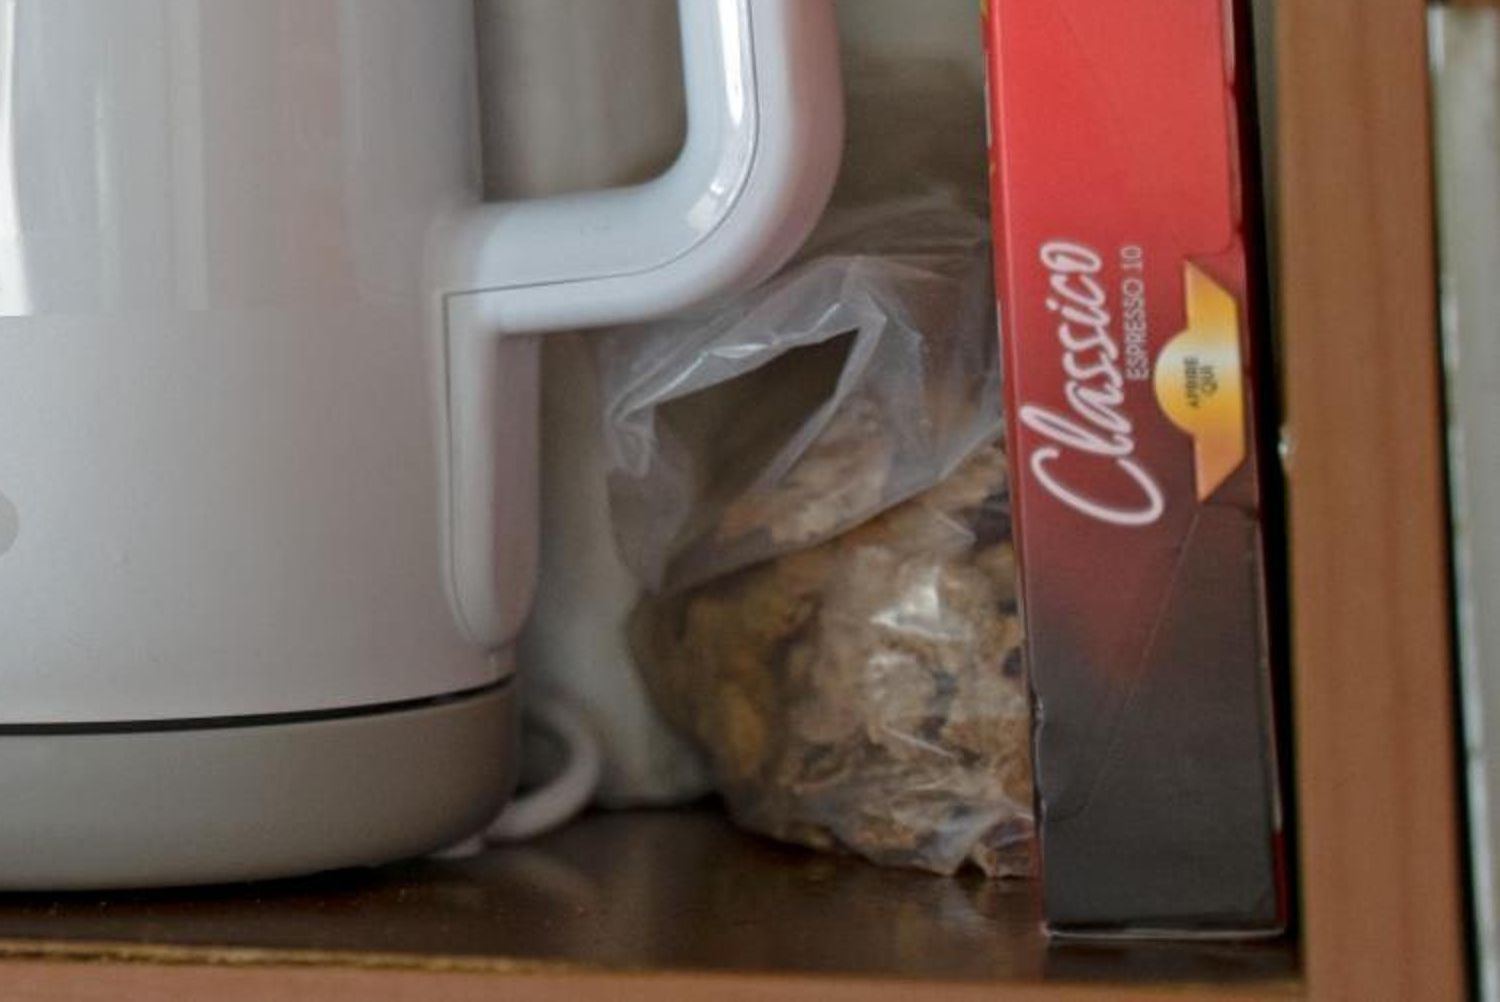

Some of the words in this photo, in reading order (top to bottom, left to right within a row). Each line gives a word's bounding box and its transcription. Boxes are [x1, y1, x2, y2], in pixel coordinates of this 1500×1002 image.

[1119, 245, 1144, 270] 10
[1121, 278, 1149, 382] ESPRESSO
[1018, 241, 1165, 526] Classico
